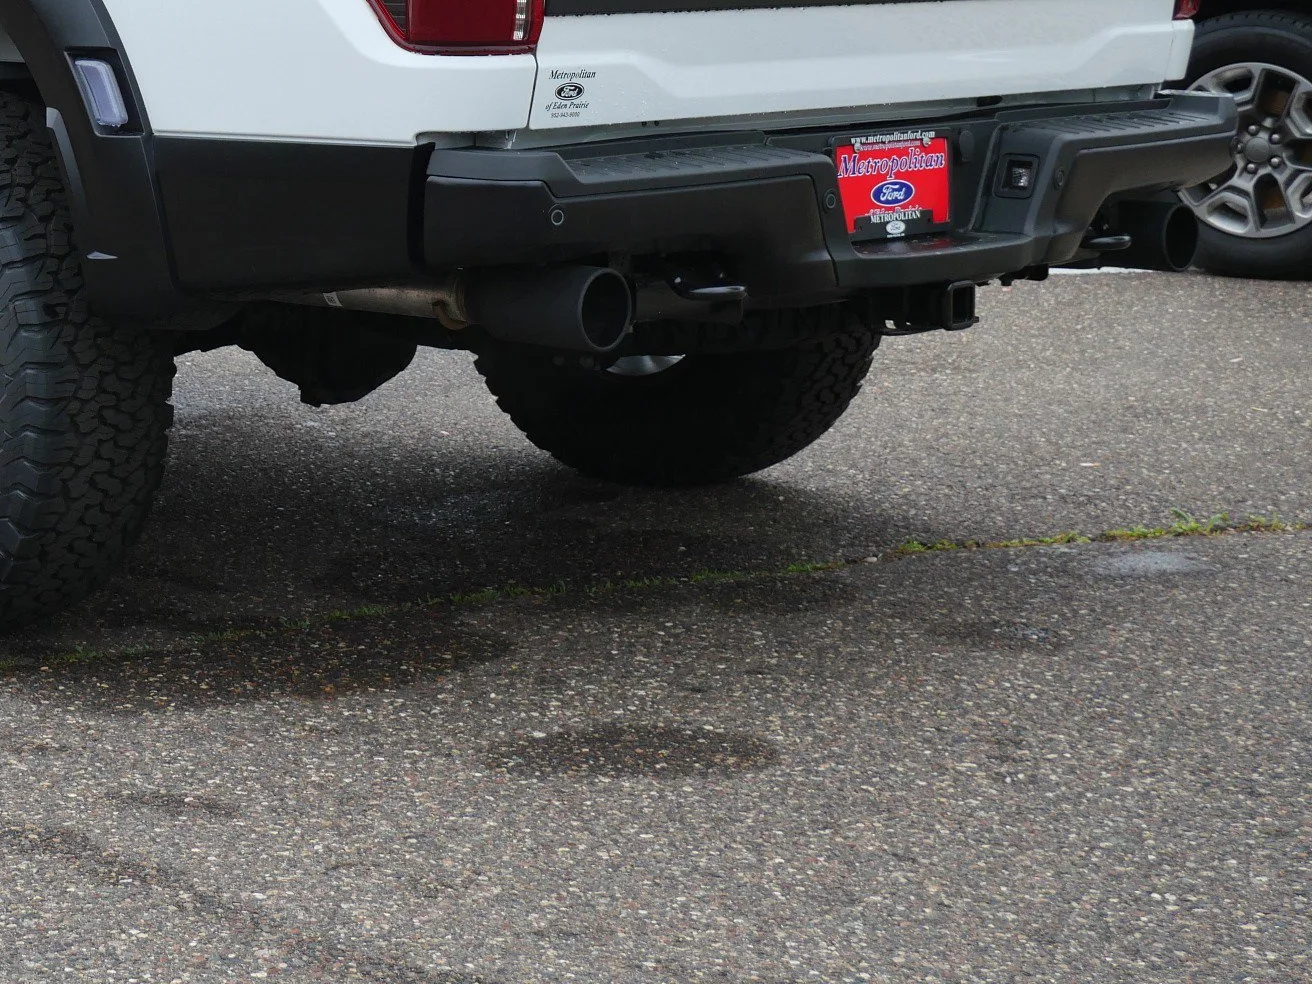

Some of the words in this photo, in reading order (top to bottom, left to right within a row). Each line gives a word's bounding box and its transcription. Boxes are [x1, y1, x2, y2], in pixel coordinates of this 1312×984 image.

[549, 69, 596, 81] Metropolitan
[545, 102, 553, 111] of
[552, 102, 568, 110] Eden
[568, 101, 589, 109] Prairie
[851, 130, 935, 144] www.metropolitanford.com
[837, 147, 945, 180] Metropolitan
[870, 210, 921, 224] METROPOLITAN
